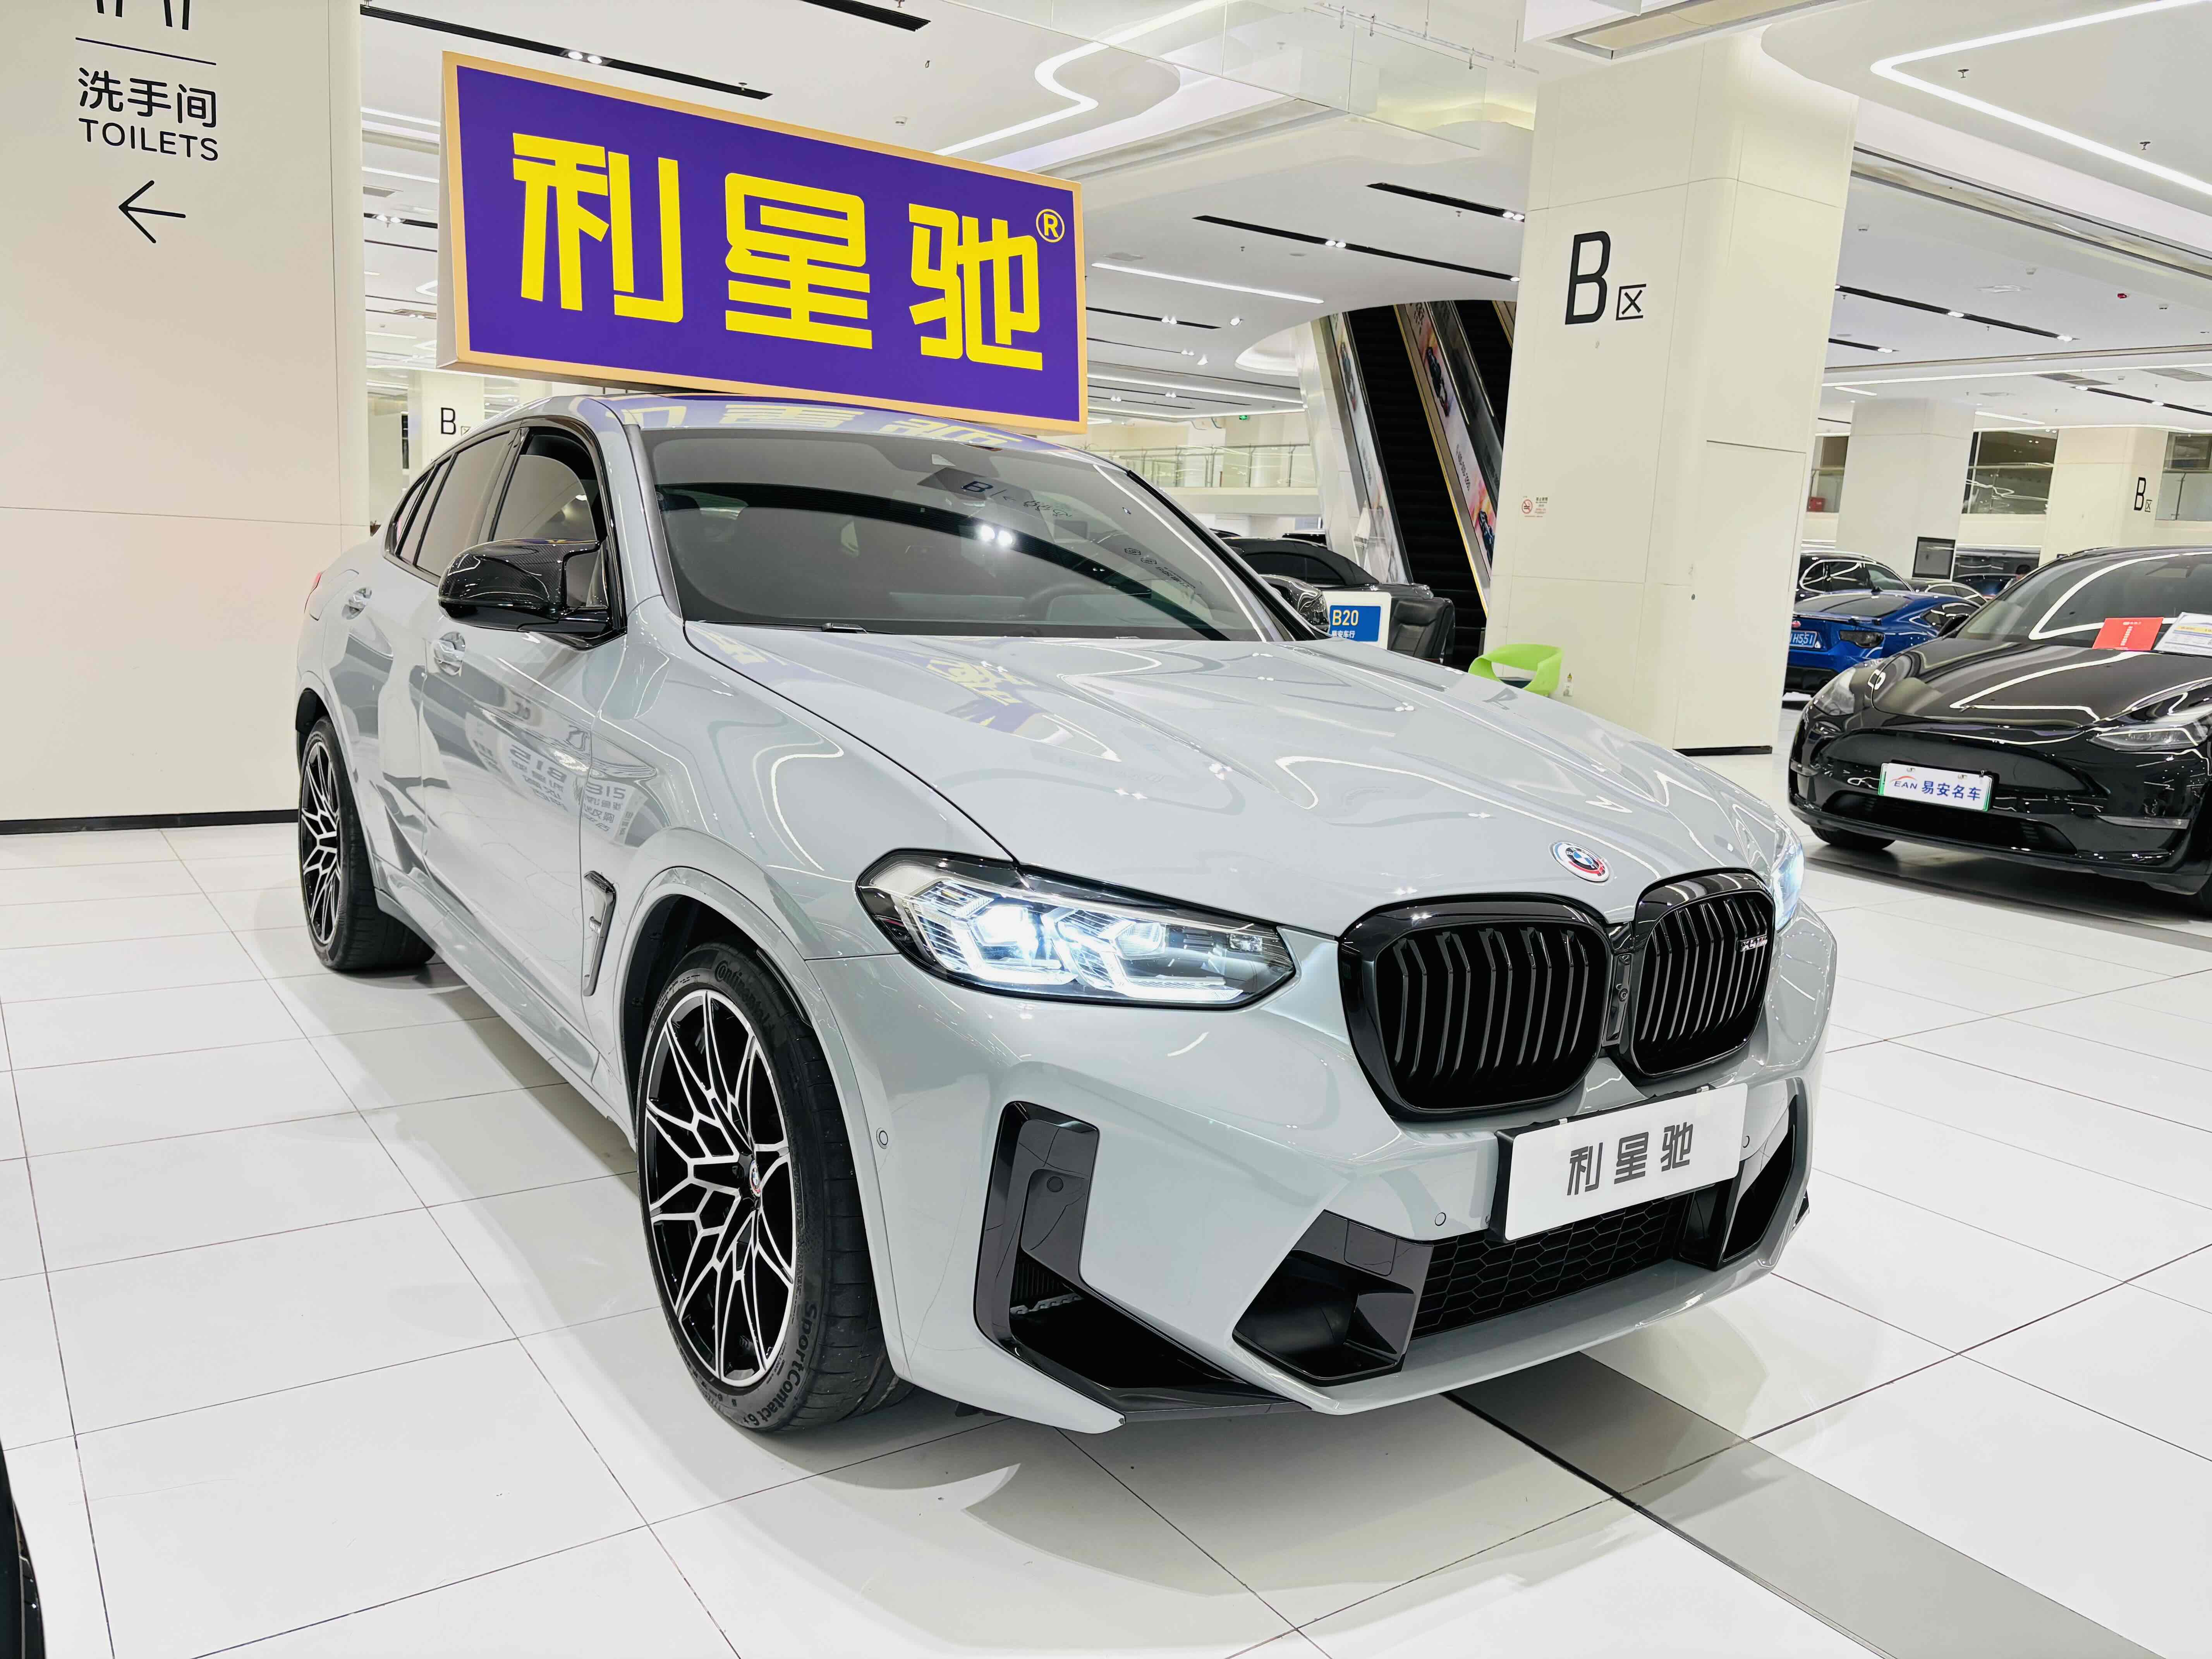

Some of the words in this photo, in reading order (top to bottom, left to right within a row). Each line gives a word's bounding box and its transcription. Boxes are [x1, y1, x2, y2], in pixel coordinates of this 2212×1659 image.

[78, 67, 216, 128] 洗手间
[78, 118, 218, 161] TOILETS
[513, 132, 1043, 371] 利星驰
[1332, 610, 1359, 626] B20
[1894, 780, 1917, 789] EAN
[1922, 780, 1982, 801] 易安名车
[1567, 1121, 1694, 1197] 利星驰
[757, 1302, 818, 1422] SportContact
